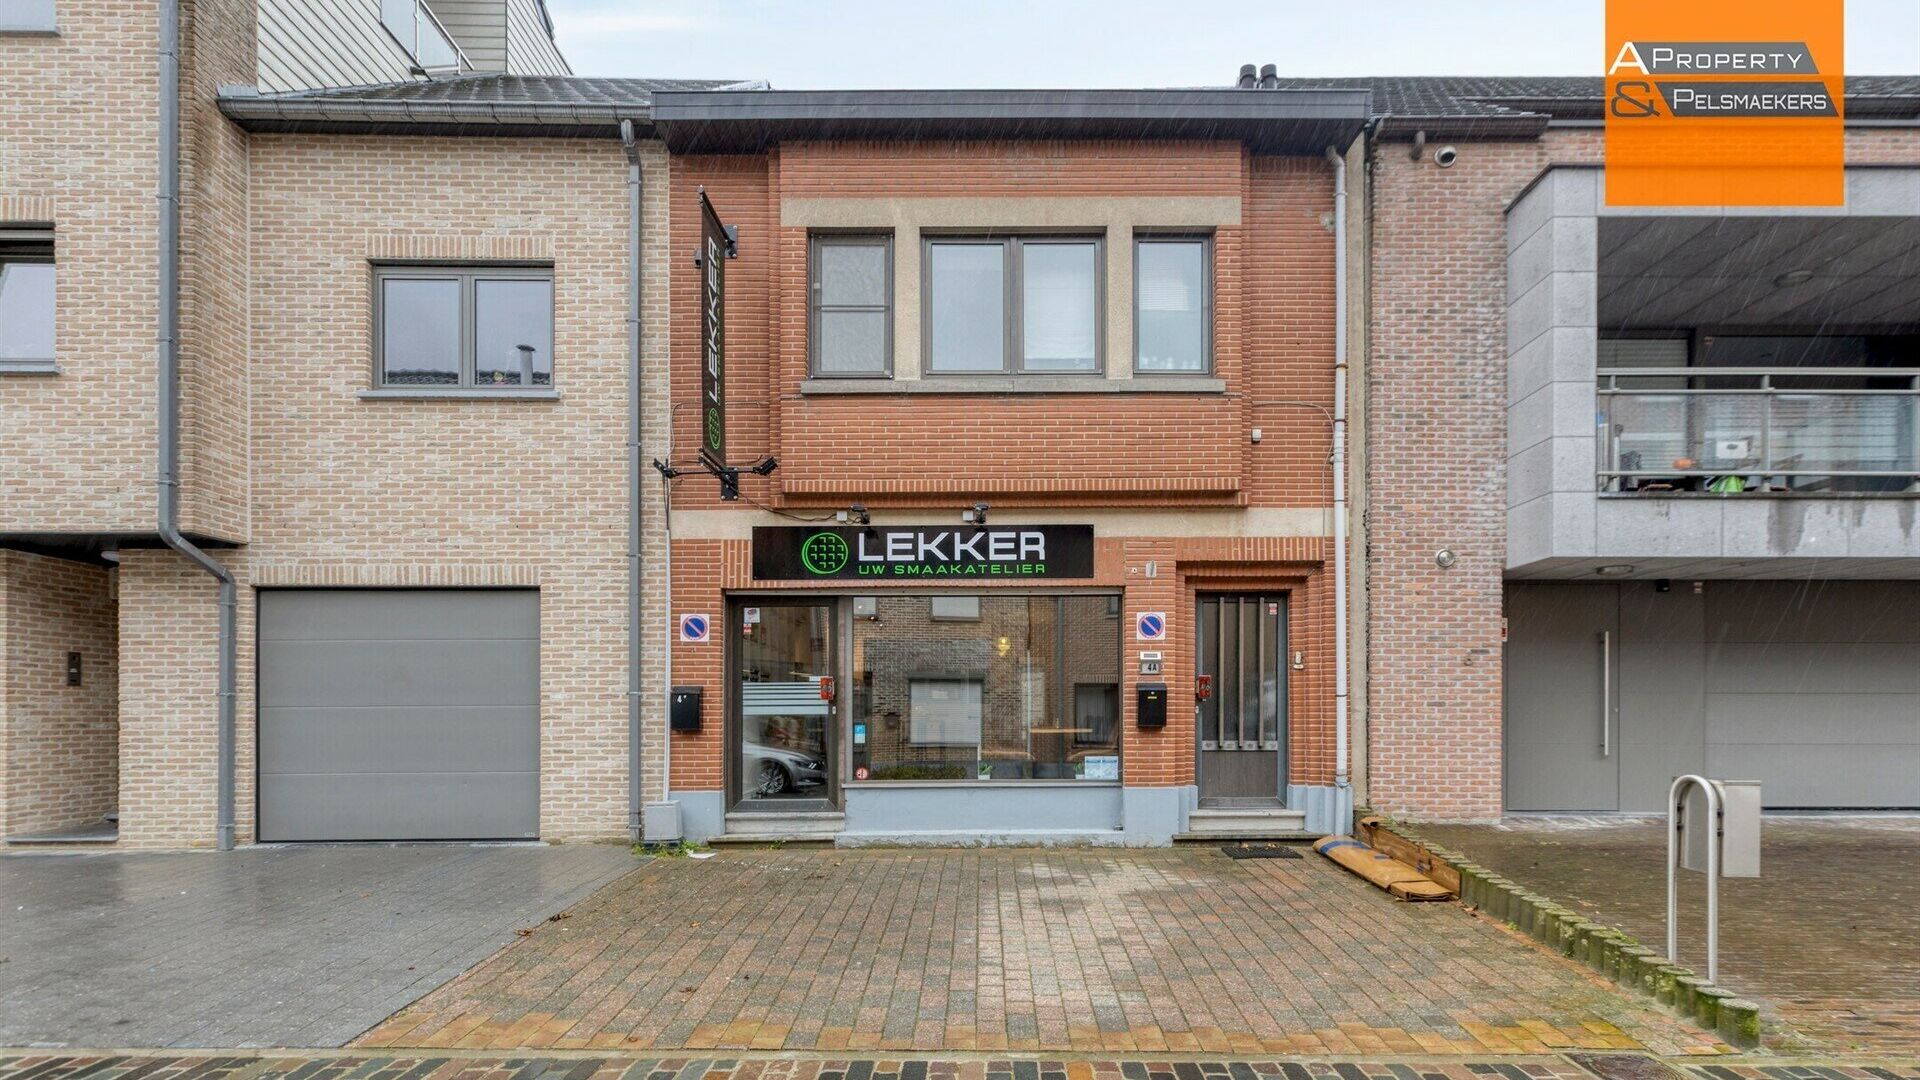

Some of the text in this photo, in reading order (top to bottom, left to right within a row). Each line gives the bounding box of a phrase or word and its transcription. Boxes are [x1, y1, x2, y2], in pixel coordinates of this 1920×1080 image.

[708, 236, 717, 403] LEKKER
[858, 531, 1046, 562] LEKKER
[858, 564, 1046, 575] UW SMAAKATELIER
[1147, 663, 1157, 672] 4A
